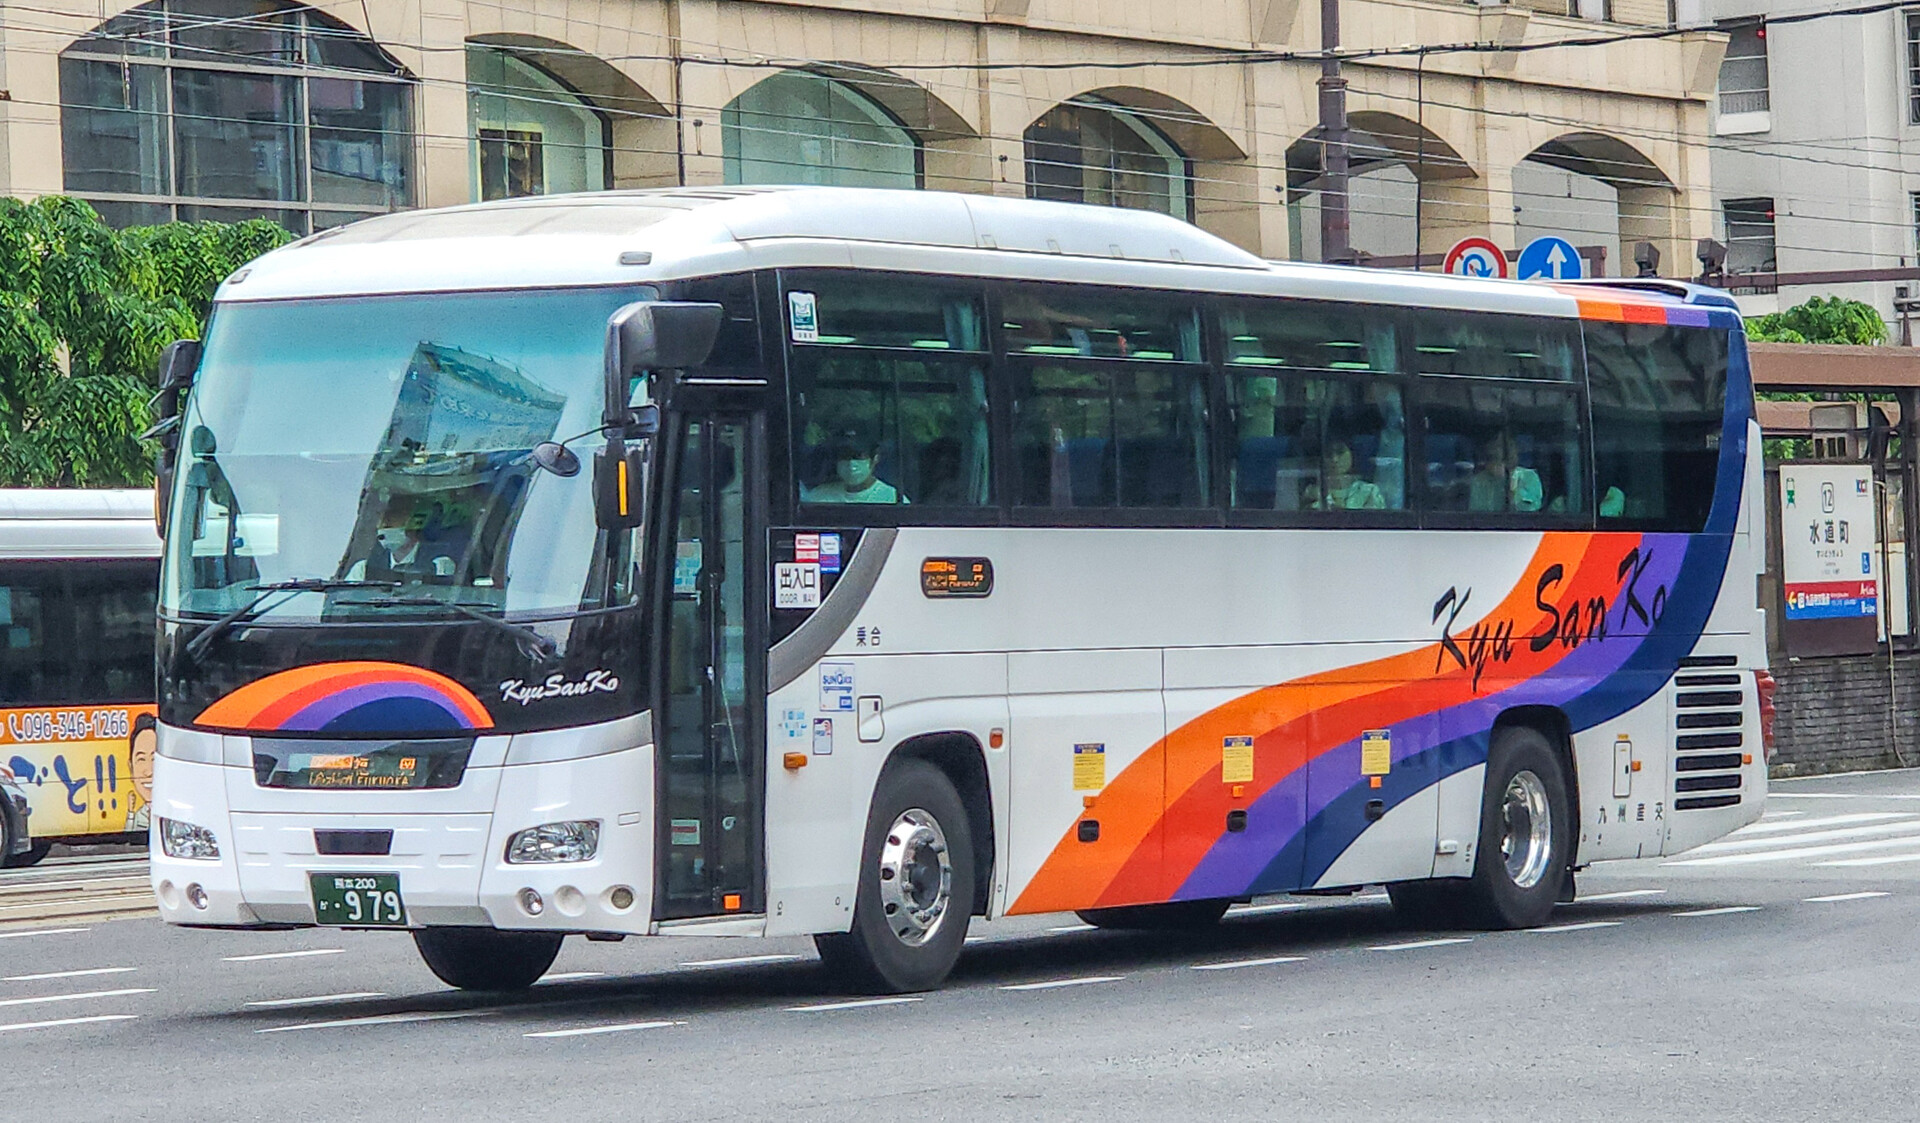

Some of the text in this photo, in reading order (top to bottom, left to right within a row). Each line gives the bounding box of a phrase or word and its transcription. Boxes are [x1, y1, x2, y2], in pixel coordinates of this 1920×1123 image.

[1823, 489, 1833, 507] 12
[1809, 519, 1849, 544] 水道町
[780, 567, 815, 589] 出入口
[1432, 546, 1666, 693] Kyu San Ko
[499, 669, 619, 706] KyuSanKo
[23, 710, 129, 740] 096-346-1266
[355, 878, 377, 889] 200
